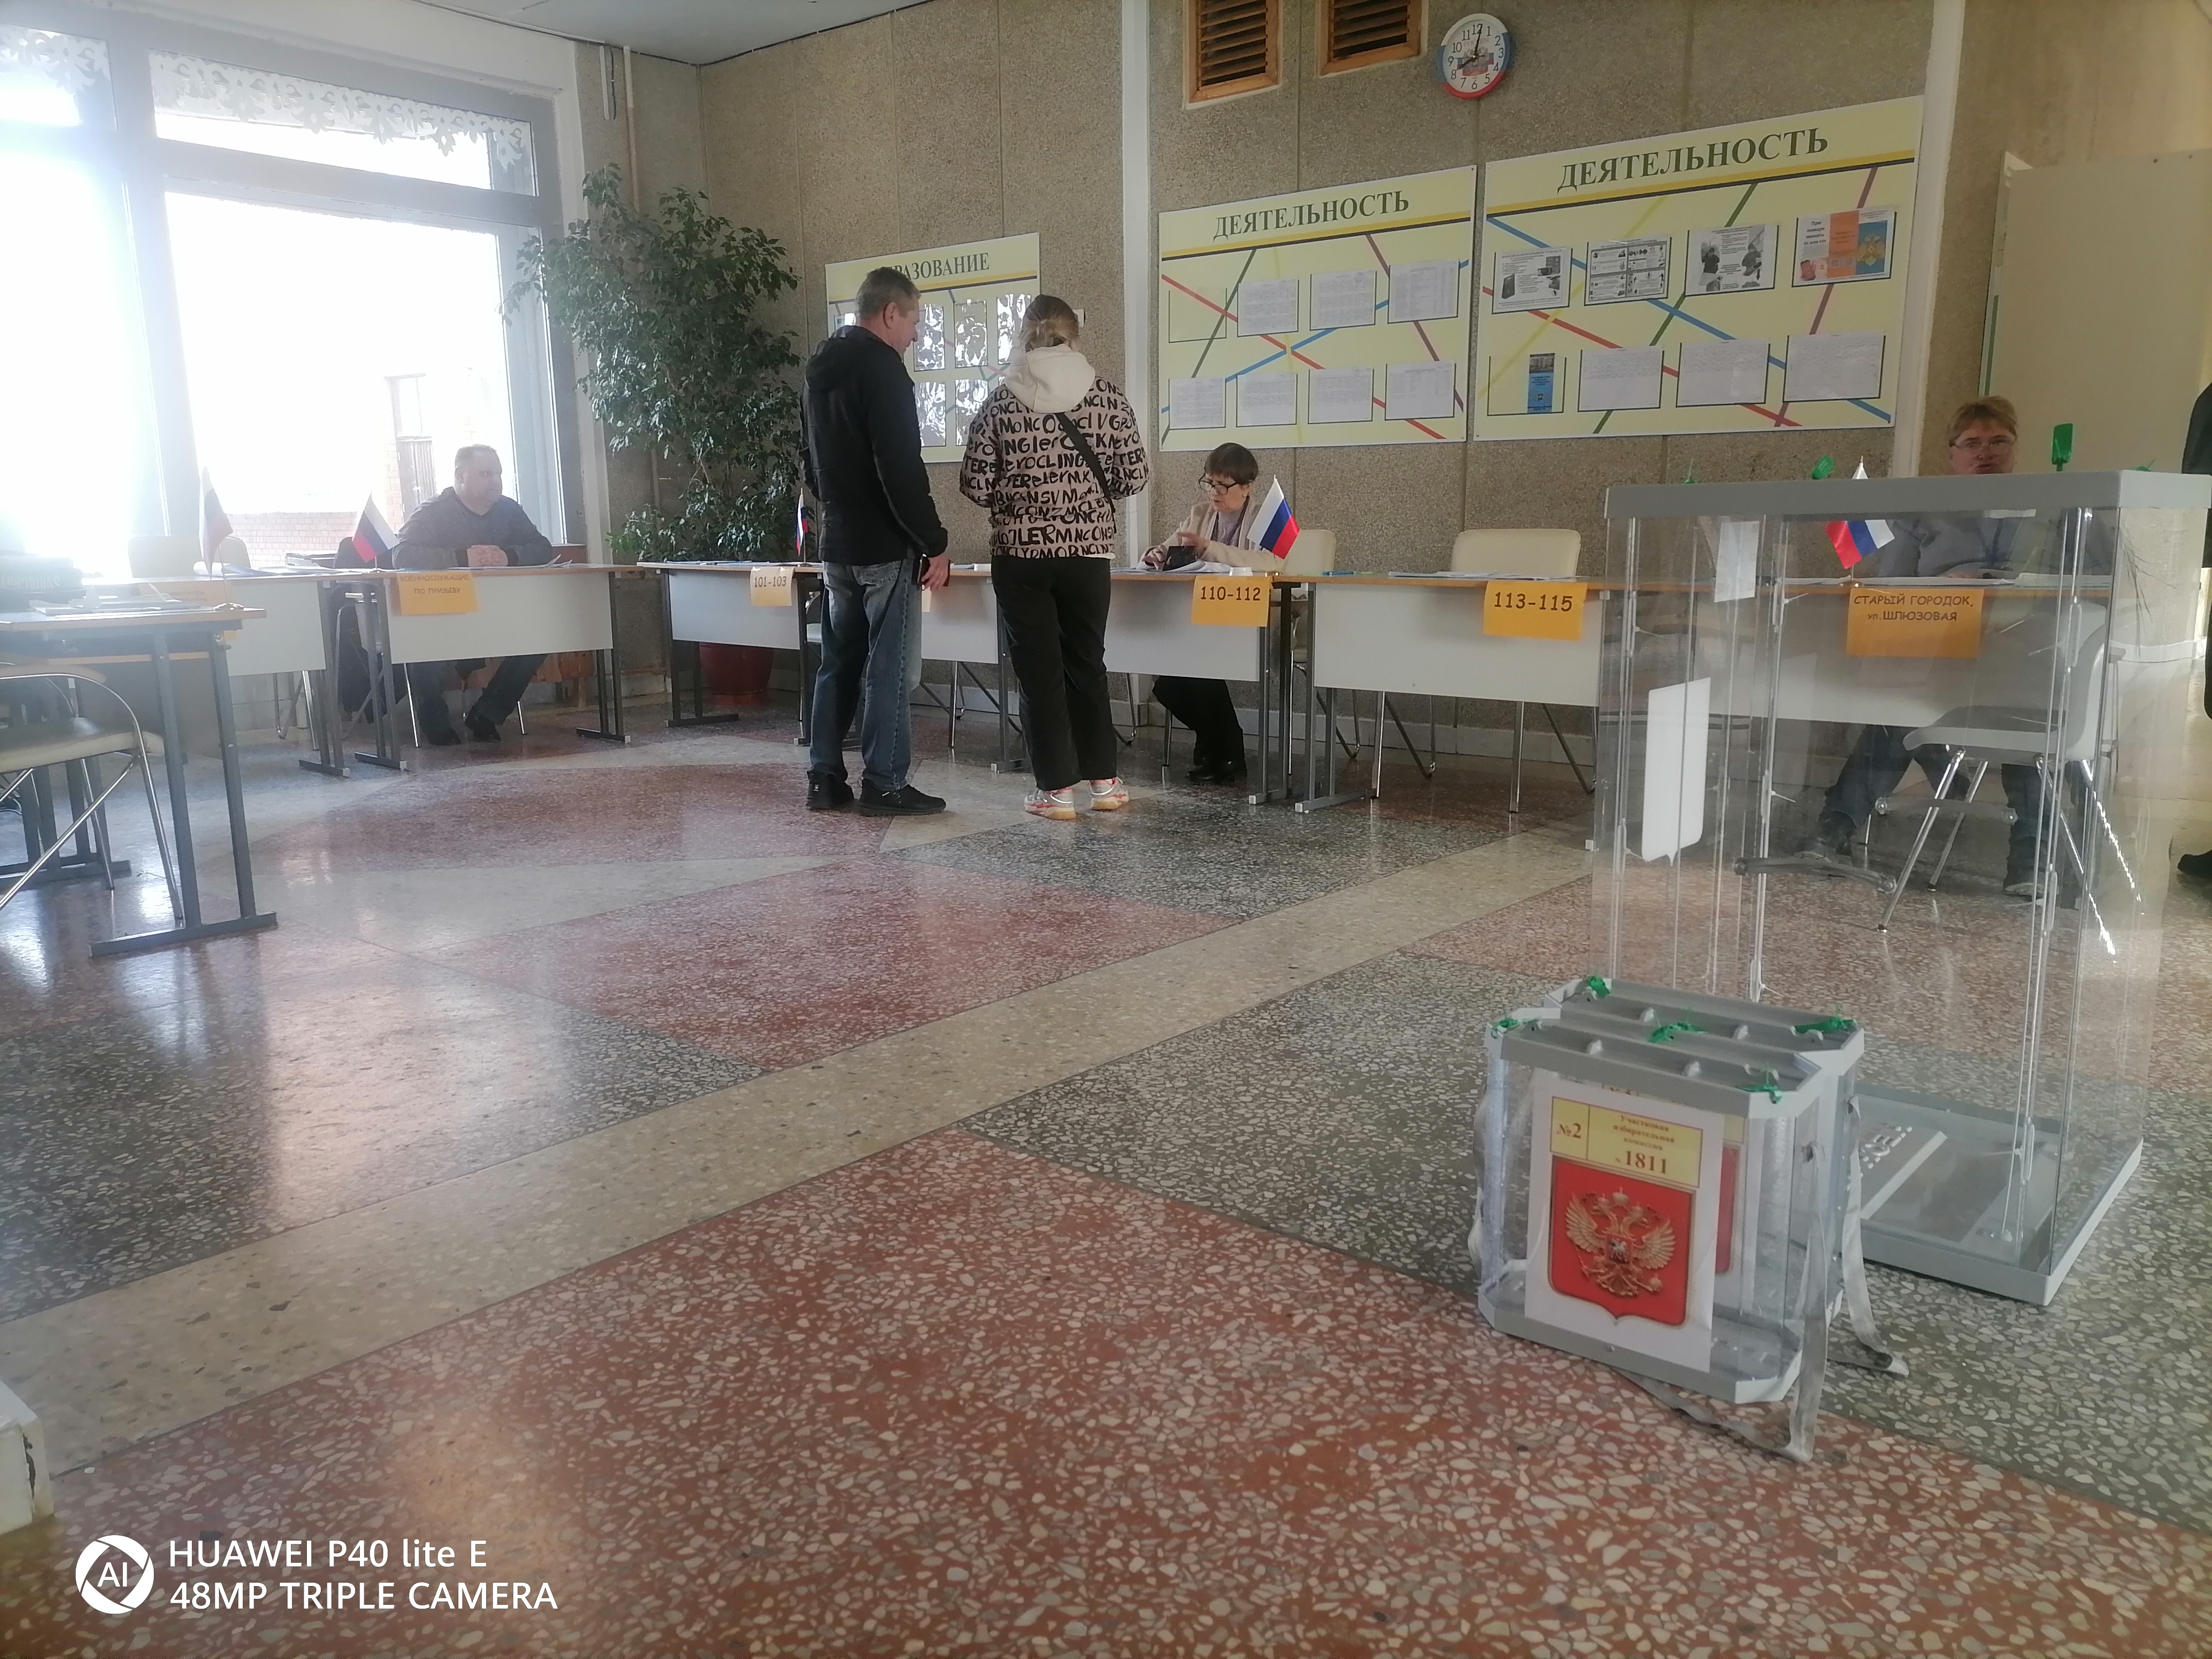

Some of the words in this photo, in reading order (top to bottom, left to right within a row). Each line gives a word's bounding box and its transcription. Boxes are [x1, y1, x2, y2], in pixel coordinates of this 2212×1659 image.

[1472, 24, 1483, 35] 12
[1486, 26, 1491, 36] 1
[1462, 30, 1471, 41] 11
[1495, 35, 1501, 46] 2
[1452, 42, 1462, 53] 10
[1498, 48, 1504, 58] 3
[1448, 56, 1454, 66] 9
[1493, 62, 1499, 72] 4
[1451, 69, 1457, 80] 8
[1484, 74, 1490, 84] 5
[1460, 77, 1467, 88] 7
[1472, 80, 1478, 89] 6
[1556, 127, 1829, 194] ДЕЯТЕЛЬНОСТЬ
[1213, 190, 1410, 242] ДЕЯТЕЛЬНОСТЬ
[889, 252, 990, 280] РАЗОВАНИЕ
[400, 573, 470, 582] ВОЕННОСЛУЖАЩИЕ
[754, 576, 787, 587] 101-103
[1199, 586, 1261, 601] 110-112
[1854, 593, 1905, 605] СТАРЫЙ
[1494, 592, 1573, 612] 113-115
[1557, 1123, 1582, 1139] №2
[1625, 1150, 1667, 1174] 1811
